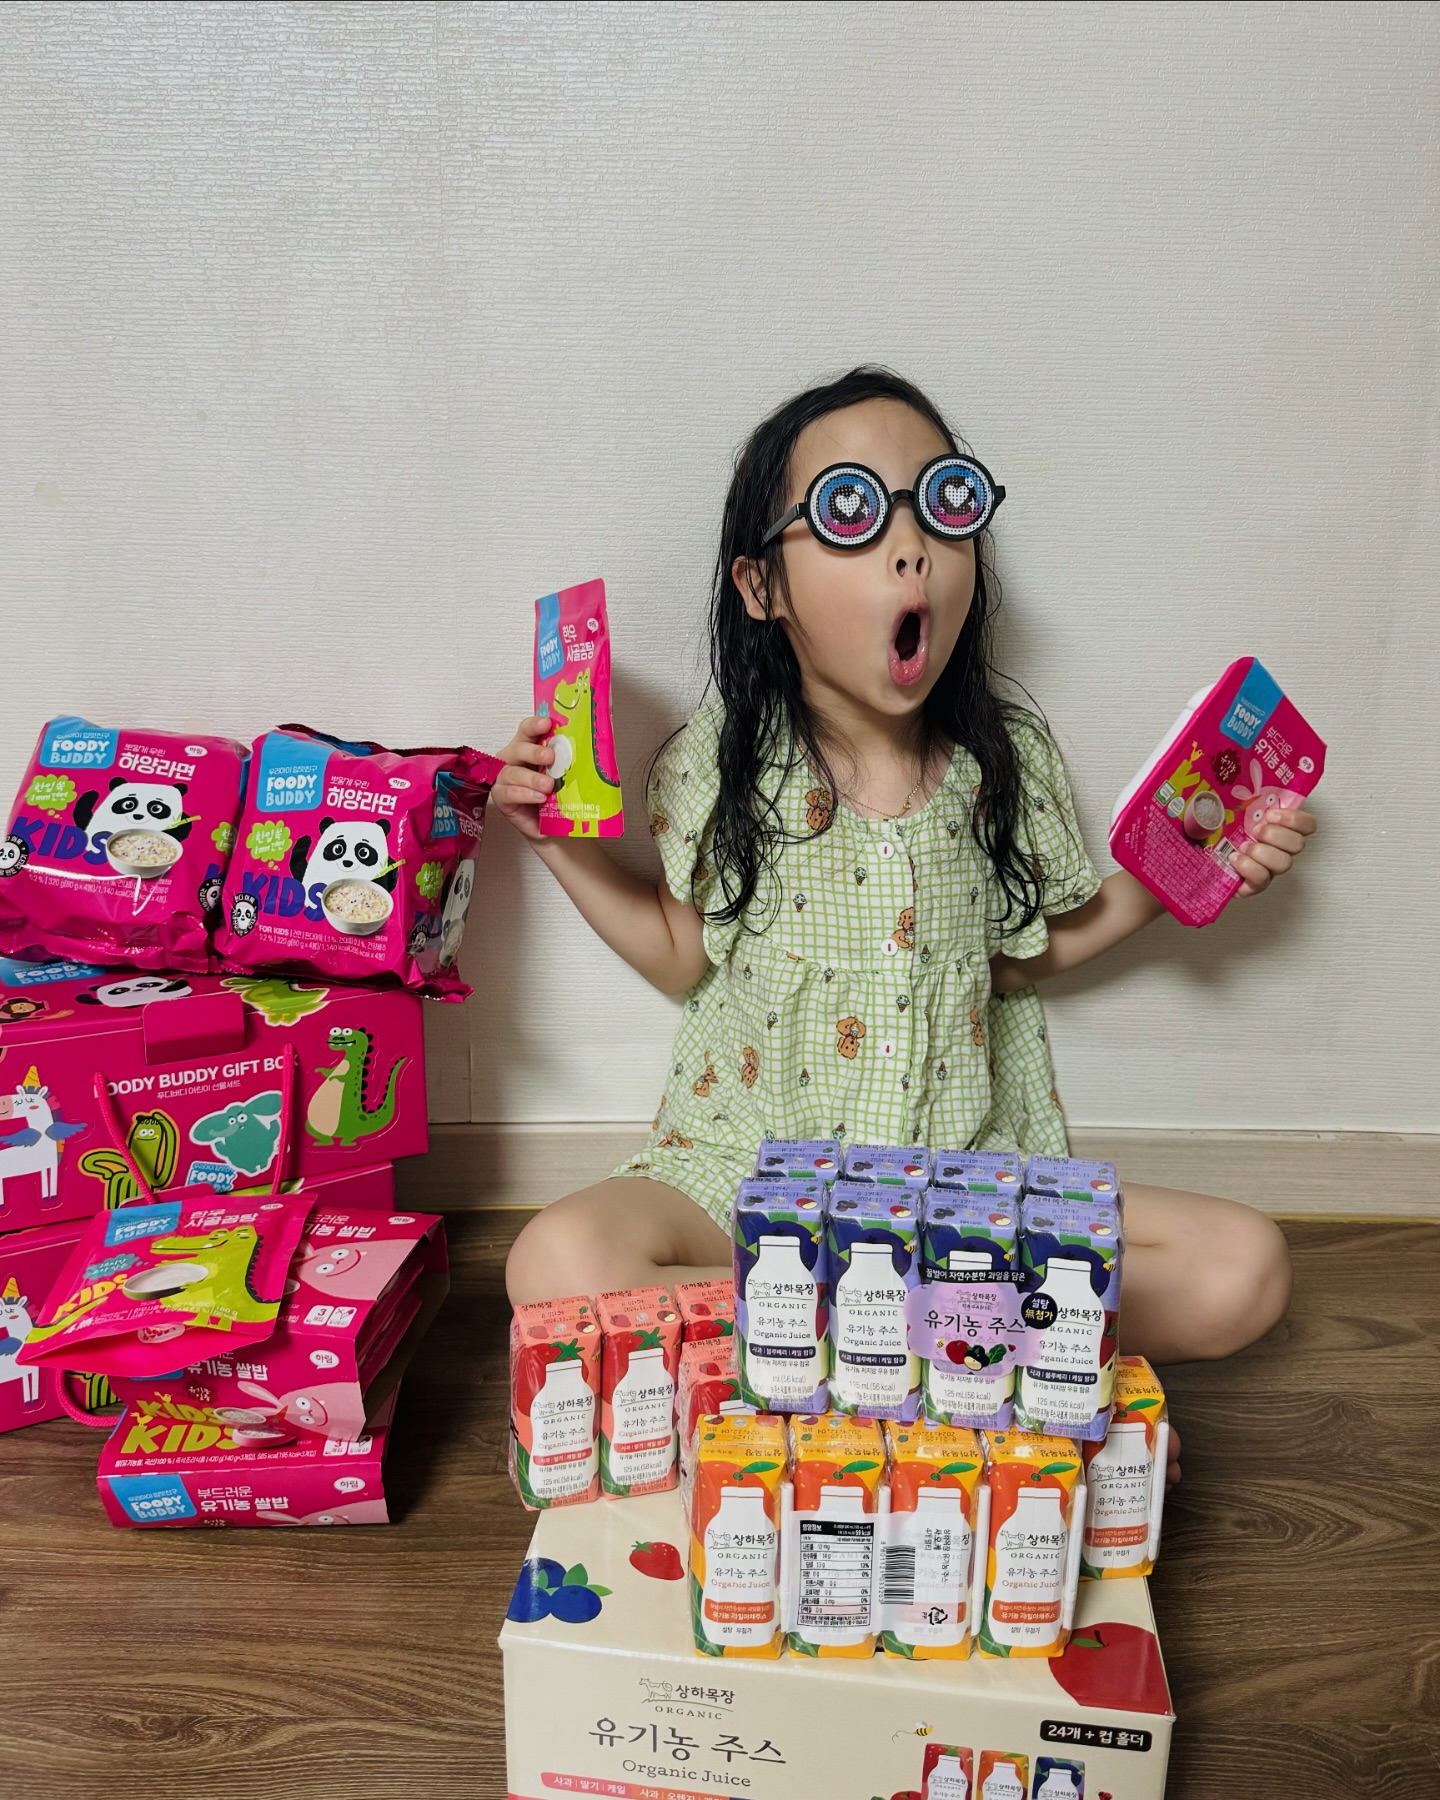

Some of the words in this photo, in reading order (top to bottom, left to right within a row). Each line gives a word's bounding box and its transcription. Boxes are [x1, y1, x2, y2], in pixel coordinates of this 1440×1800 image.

[540, 637, 558, 658] FOODY
[566, 640, 594, 662] 사골곰탕
[1234, 704, 1261, 729] FOODY
[1227, 716, 1254, 740] BUDDY
[52, 740, 110, 752] FOODY
[1266, 726, 1293, 758] 부드러운
[51, 752, 107, 764] BUDDY
[1254, 739, 1280, 769] 유기농
[1275, 762, 1294, 786] 쌀밥
[119, 752, 196, 780] 하양라면
[267, 775, 318, 791] FOODY
[266, 790, 316, 806] BUDDY
[326, 786, 398, 816] 하양라면
[11, 816, 113, 865] KIDS
[242, 871, 329, 922] KIDS
[259, 924, 272, 933] FOR
[273, 926, 289, 936] KIDS
[159, 1066, 218, 1088] BUDDY
[222, 1060, 260, 1078] GIFT
[157, 1088, 187, 1099] 푸디버디
[188, 1085, 210, 1095] 어린이
[212, 1080, 242, 1091] 선물세트
[190, 1170, 234, 1184] FOODY
[184, 1212, 259, 1228] 사골곰탕
[190, 1209, 226, 1219] 한우
[115, 1217, 171, 1235] FOODY
[114, 1223, 169, 1242] BUDDY
[336, 1226, 376, 1239] 쌀밥
[926, 1269, 948, 1279] 꿀벌이
[949, 1270, 986, 1280] 자연수분한
[988, 1272, 1009, 1280] 과일을
[1012, 1272, 1026, 1282] 담은
[681, 1281, 712, 1290] 상하목장
[773, 1283, 814, 1296] 상하목장
[602, 1290, 632, 1298] 상하목장
[864, 1290, 906, 1302] 상하목장
[972, 1293, 996, 1301] 상하목장
[521, 1302, 552, 1310] 상하목장
[759, 1302, 808, 1310] ORGANIC
[1031, 1298, 1049, 1309] 설탕
[1025, 1310, 1053, 1320] 無첨가
[1058, 1308, 1102, 1322] 상하목장
[757, 1316, 786, 1328] 유기농
[788, 1318, 808, 1327] 주스
[924, 1310, 982, 1337] 유기농
[988, 1317, 1025, 1336] 주스
[754, 1330, 787, 1340] Organic
[846, 1324, 876, 1336] 유기농
[878, 1326, 898, 1334] 주스
[689, 1339, 720, 1348] 상하목장
[844, 1336, 876, 1346] Organic
[1040, 1340, 1068, 1352] 유기농
[1070, 1343, 1091, 1352] 주스
[315, 1354, 334, 1364] 하림
[1070, 1356, 1094, 1364] Juice
[188, 1361, 232, 1378] 유기농
[236, 1364, 268, 1380] 쌀밥
[1045, 1371, 1067, 1380] 블루베리
[638, 1384, 672, 1398] 상하목장
[556, 1396, 592, 1410] 상하목장
[625, 1402, 666, 1413] ORGANIC
[544, 1414, 586, 1424] ORGANIC
[622, 1416, 647, 1428] 유기농
[541, 1430, 566, 1440] 유기농
[569, 1428, 586, 1436] 주스
[619, 1428, 648, 1438] Organic
[650, 1425, 668, 1433] Juice
[538, 1441, 569, 1450] Organic
[570, 1438, 588, 1446] Juice
[844, 1448, 880, 1456] 상하목장
[942, 1450, 978, 1458] 상하목장
[1040, 1450, 1076, 1458] 상하목장
[1116, 1462, 1152, 1477] 상하목장
[340, 1480, 358, 1488] 하림
[198, 1486, 252, 1498] 부드러운
[131, 1495, 182, 1511] FOODY
[201, 1499, 251, 1512] 유기농
[254, 1496, 288, 1510] 쌀밥
[1097, 1497, 1126, 1506] 유기농
[1130, 1496, 1146, 1504] 주스
[136, 1505, 186, 1519] BUDDY
[1094, 1508, 1126, 1516] Organic
[1128, 1506, 1146, 1514] Juice
[802, 1524, 822, 1532] 영양정보
[733, 1532, 776, 1545] 상하목장
[1027, 1532, 1066, 1546] 상하목장
[942, 1554, 950, 1570] 유기농
[715, 1568, 745, 1578] 유기농
[748, 1568, 768, 1578] 주스
[1007, 1568, 1037, 1578] 유기농
[1040, 1568, 1058, 1577] 주스
[712, 1578, 746, 1588] Organic
[1002, 1580, 1037, 1588] Organic
[675, 1684, 735, 1704] 상하목장
[654, 1705, 722, 1720] ORGANIC
[589, 1717, 700, 1762] 유기농
[711, 1733, 787, 1764] 주스
[1048, 1724, 1081, 1740] 24개
[1099, 1730, 1112, 1743] 컵
[1115, 1733, 1144, 1746] 홀더
[622, 1759, 697, 1779] Organic
[702, 1770, 751, 1788] Juice
[944, 1776, 966, 1784] 상하목장
[554, 1776, 573, 1788] 사과
[580, 1779, 598, 1791] 딸기
[608, 1783, 626, 1796] 케일
[640, 1788, 659, 1800] 사과
[998, 1784, 1022, 1792] 상하목장
[1054, 1790, 1078, 1798] 상하목장
